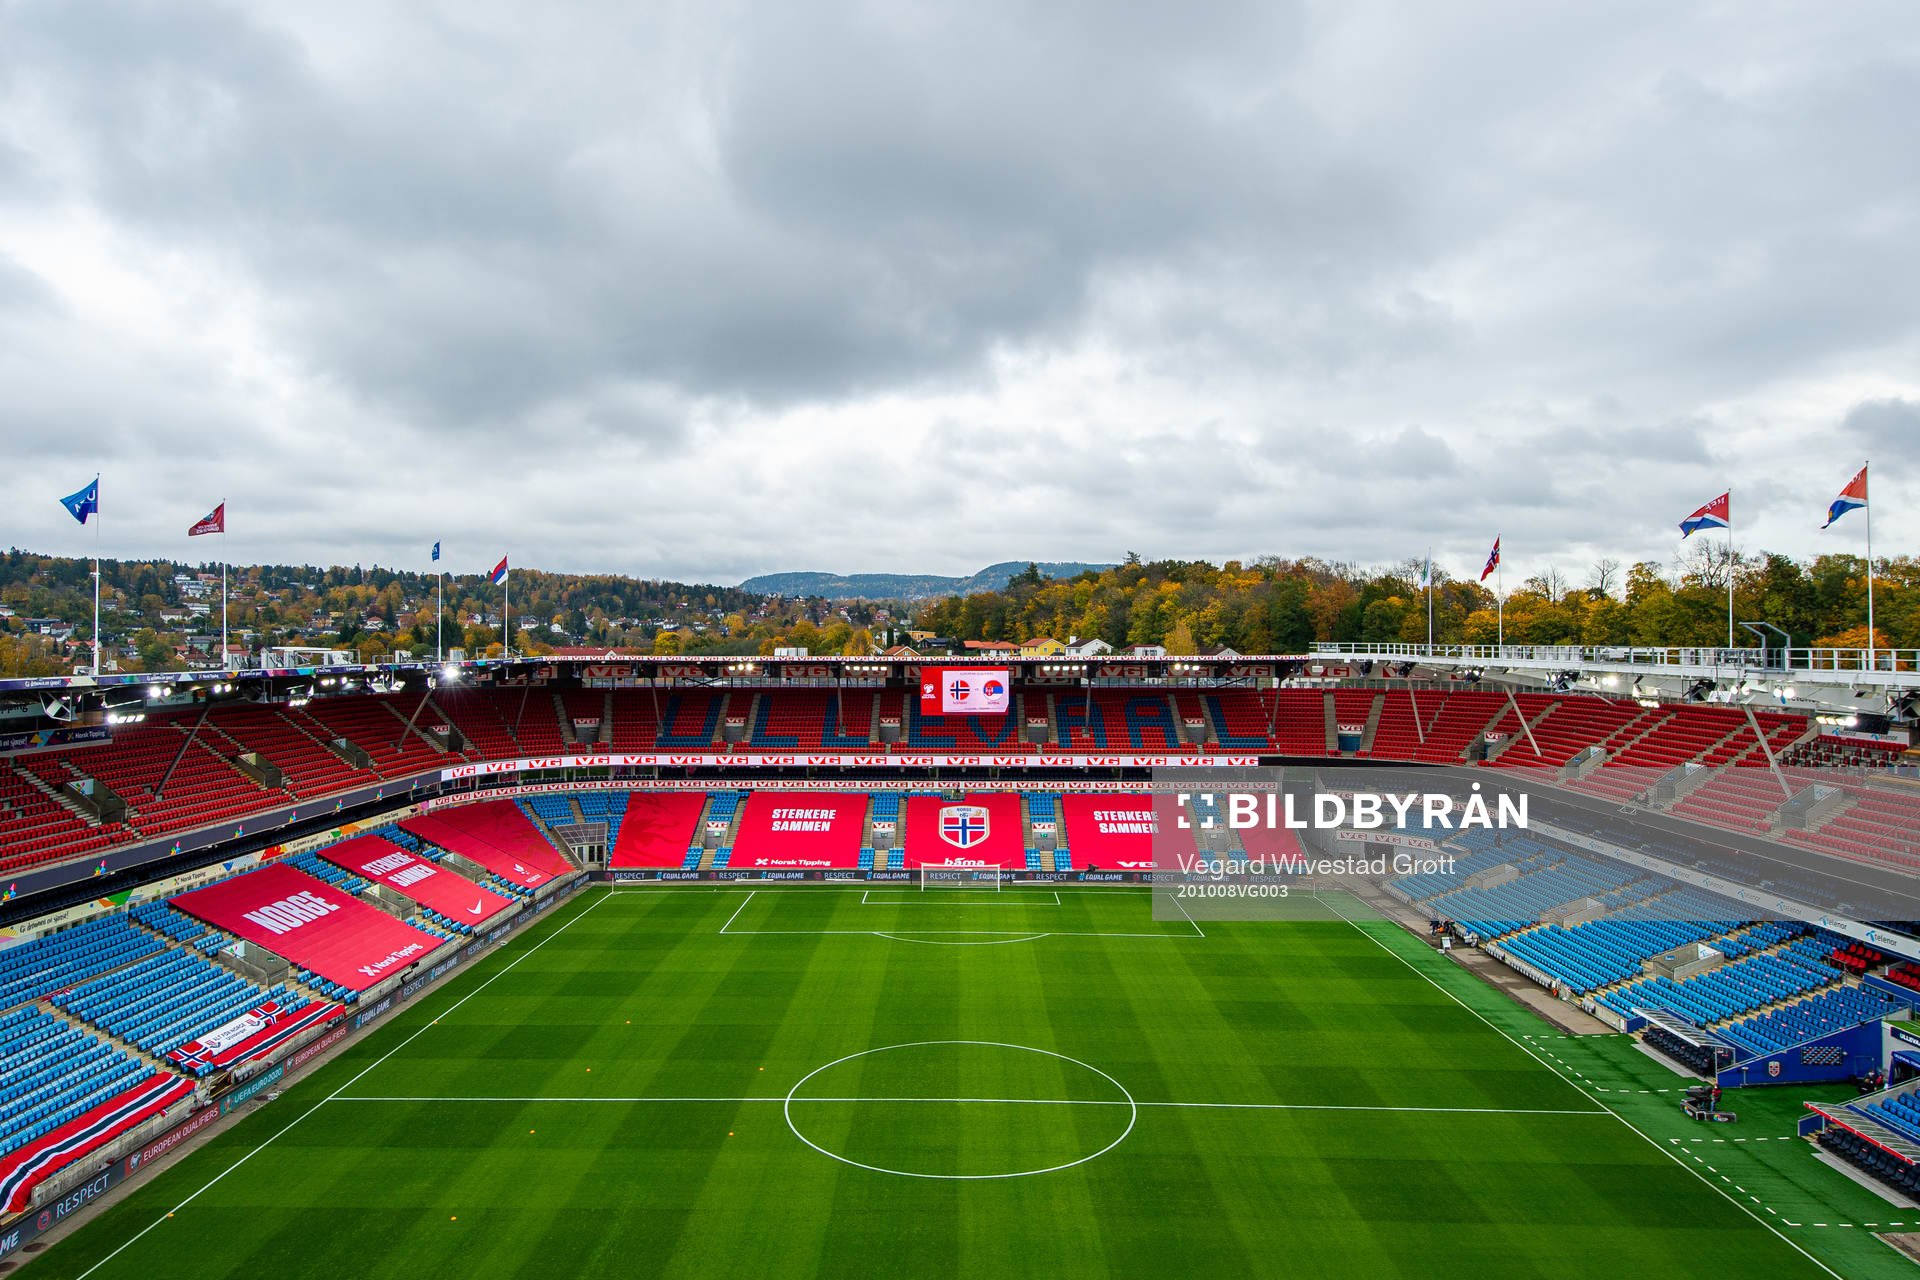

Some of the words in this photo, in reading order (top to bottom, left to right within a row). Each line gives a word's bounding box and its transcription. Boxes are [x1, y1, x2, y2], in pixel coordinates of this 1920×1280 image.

[588, 665, 631, 677] VG
[662, 665, 704, 677] VG
[785, 665, 829, 677] VG
[1101, 665, 1145, 677] VG
[1225, 665, 1270, 677] VG
[453, 766, 476, 777] VG
[487, 762, 516, 772] VG
[529, 759, 562, 768] VG
[576, 756, 610, 765] VG
[624, 756, 657, 765] VG
[670, 756, 702, 765] VG
[716, 756, 748, 765] VG
[762, 756, 794, 765] VG
[808, 756, 841, 765] VG
[854, 756, 887, 765] VG
[900, 756, 933, 765] VG
[947, 756, 980, 765] VG
[993, 756, 1026, 765] VG
[1040, 756, 1073, 765] VG
[1087, 756, 1120, 765] VG
[1134, 756, 1167, 765] VG
[1181, 756, 1214, 765] VG
[1228, 756, 1258, 765] VG
[436, 797, 450, 805] VG
[452, 793, 471, 801] VG
[474, 790, 492, 798] VG
[496, 787, 517, 795] VG
[772, 809, 836, 820] STERKERE
[1094, 811, 1159, 822] STERKERE
[772, 821, 831, 832] SAMMEN
[1099, 823, 1159, 834] SAMMEN
[361, 851, 416, 876] STERKERE
[798, 859, 831, 867] Tipping
[387, 863, 437, 888] SAMMEN
[242, 890, 341, 935] NORGE
[372, 952, 399, 970] Norsk
[393, 943, 423, 958] Tipping
[403, 976, 425, 998] RESPECT
[295, 1044, 321, 1065] EUROPEAN
[320, 1027, 347, 1049] QUALIFIERS
[234, 1089, 252, 1104] UEFA
[251, 1076, 268, 1094] EURO
[267, 1067, 283, 1085] 2020
[143, 1129, 183, 1162] EUROPEAN
[182, 1106, 219, 1138] QUALIFIERS
[56, 1172, 111, 1219] RESPECT
